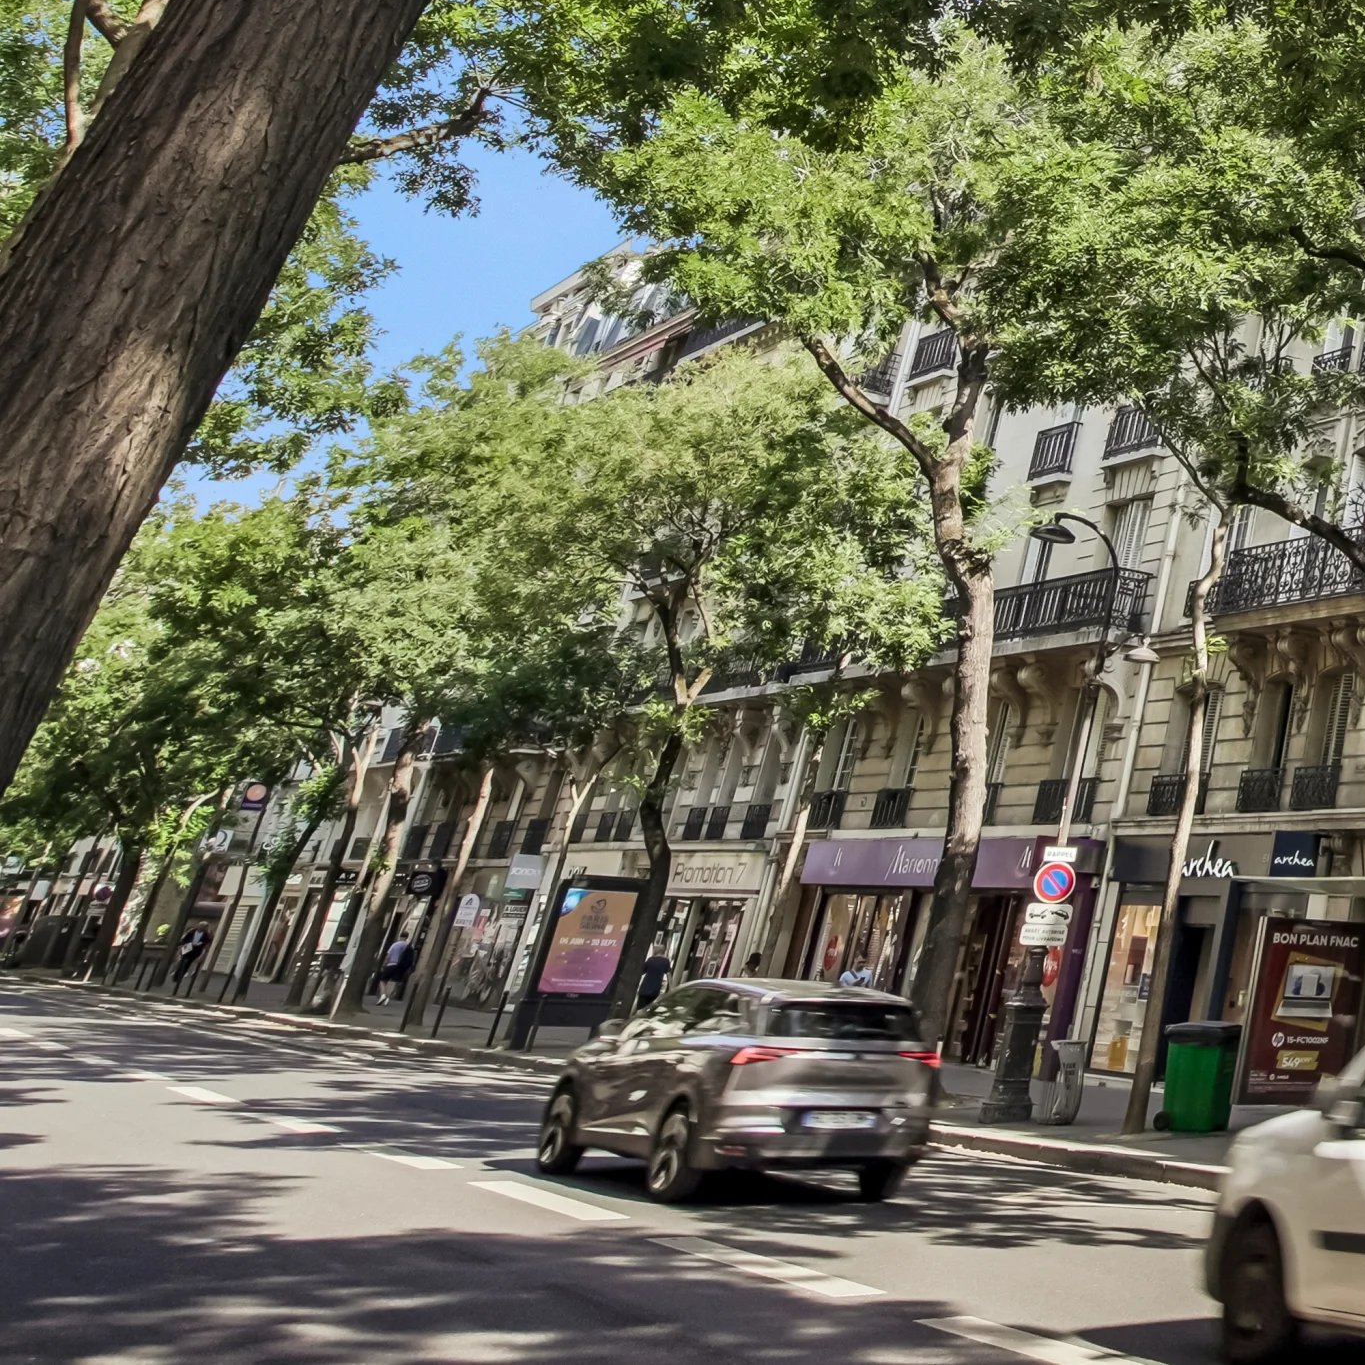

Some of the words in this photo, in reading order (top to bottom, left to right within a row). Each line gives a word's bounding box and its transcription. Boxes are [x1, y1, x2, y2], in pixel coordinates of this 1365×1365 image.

[884, 844, 939, 881] Marionn
[1046, 850, 1074, 859] RAPPEL
[1273, 850, 1315, 867] archea
[672, 862, 734, 884] Promotion
[735, 862, 748, 884] 7
[1272, 932, 1298, 945] BON
[1300, 933, 1328, 947] PLAN
[1329, 935, 1360, 948] FNAC
[1281, 1056, 1300, 1068] 549
